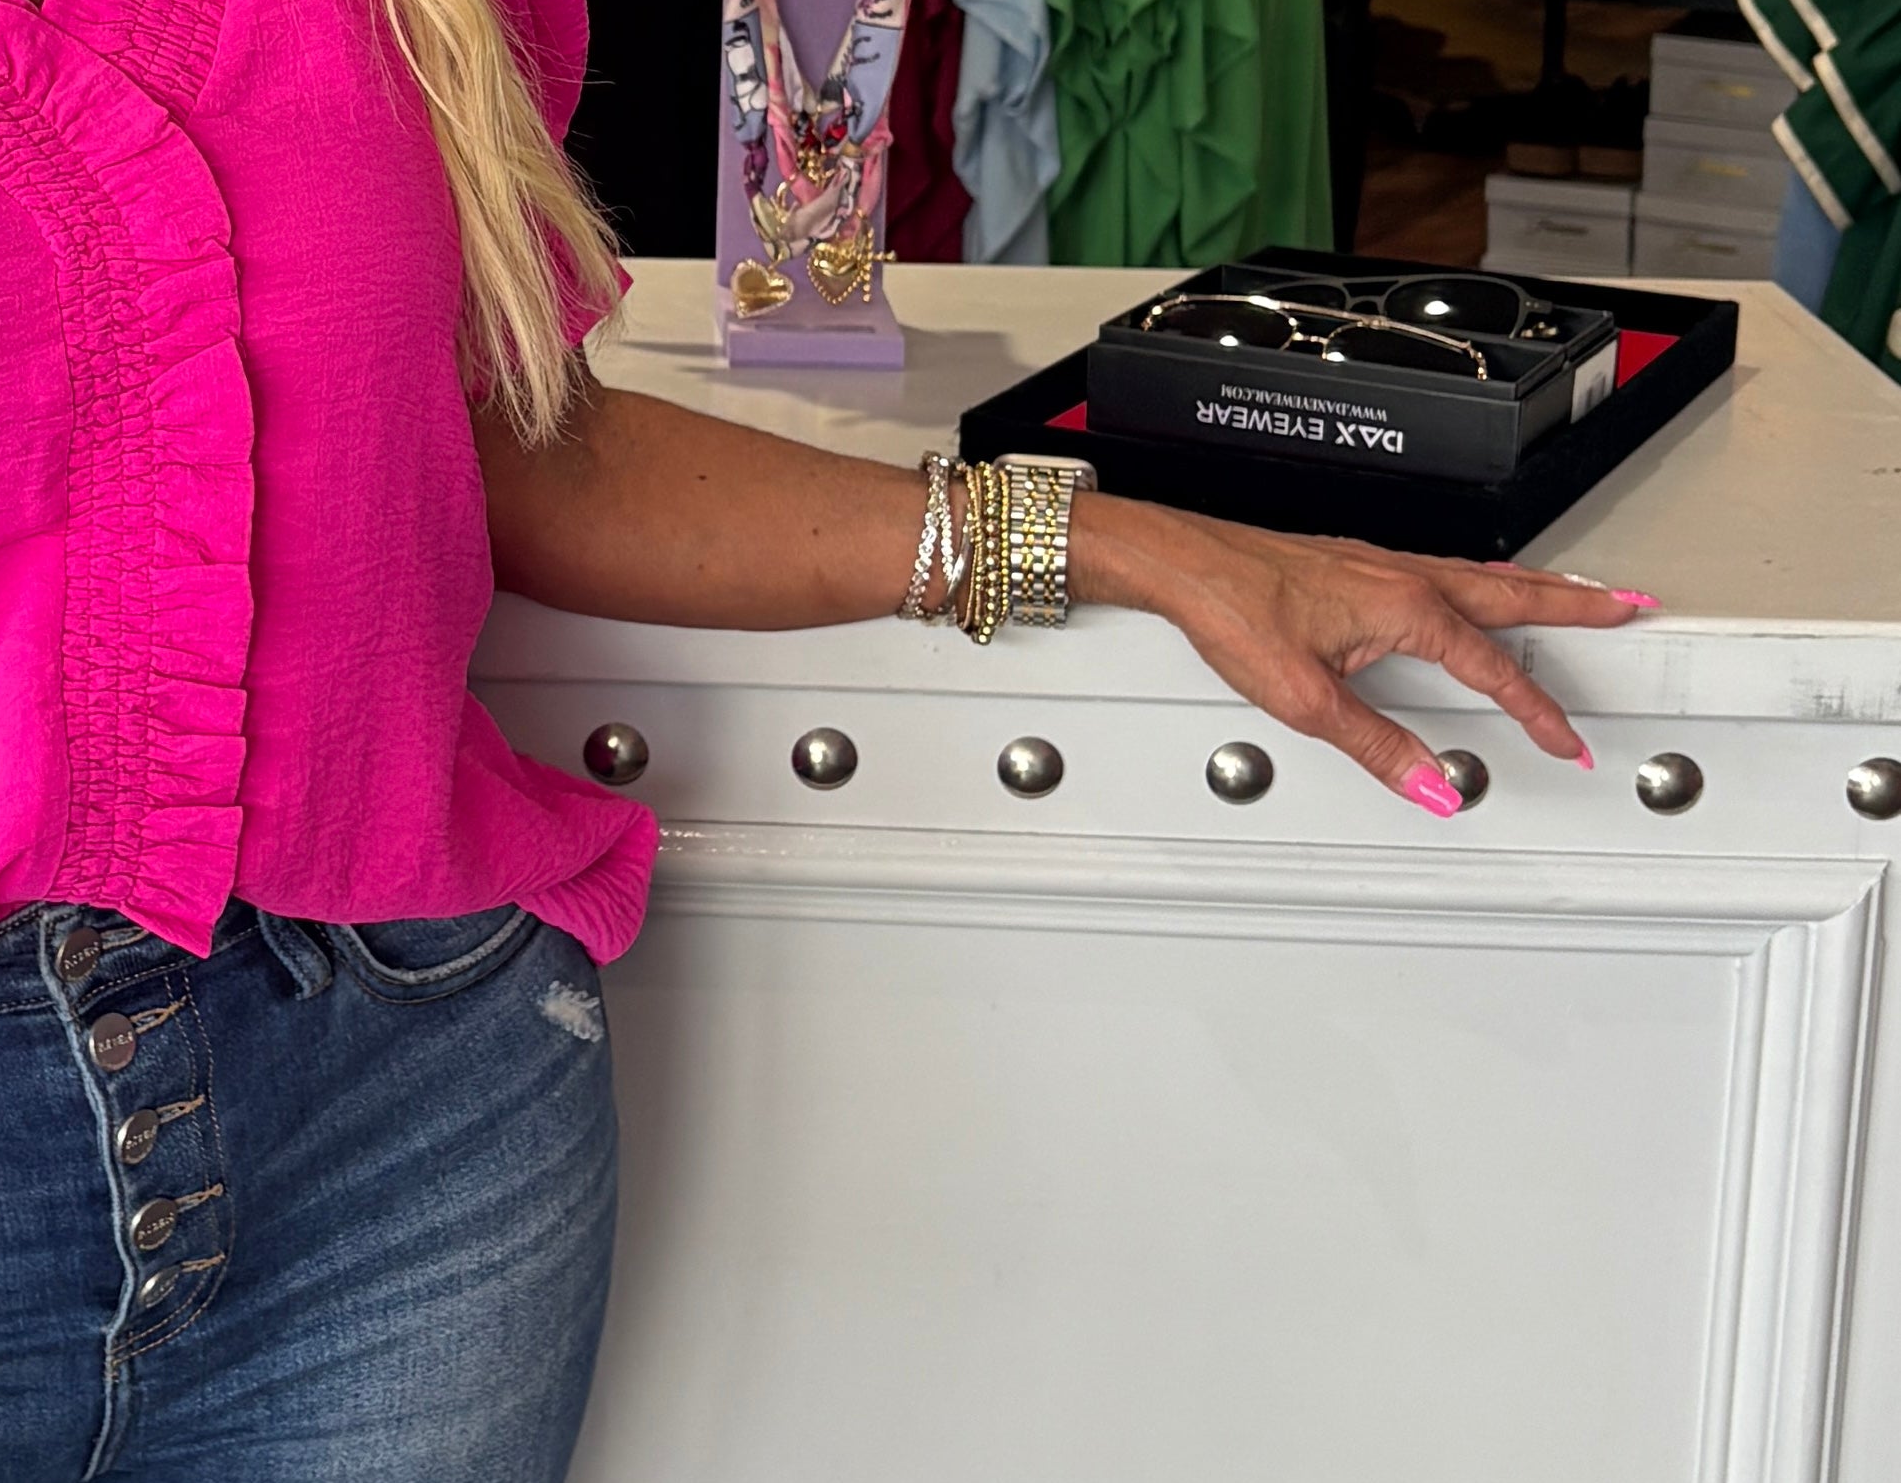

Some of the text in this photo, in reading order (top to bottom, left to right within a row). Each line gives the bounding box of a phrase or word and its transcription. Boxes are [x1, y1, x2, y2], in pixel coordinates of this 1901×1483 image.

[1196, 399, 1404, 454] DAX EYEWEAR
[1220, 383, 1388, 423] WWW.DAXEYEWEAR.COM
